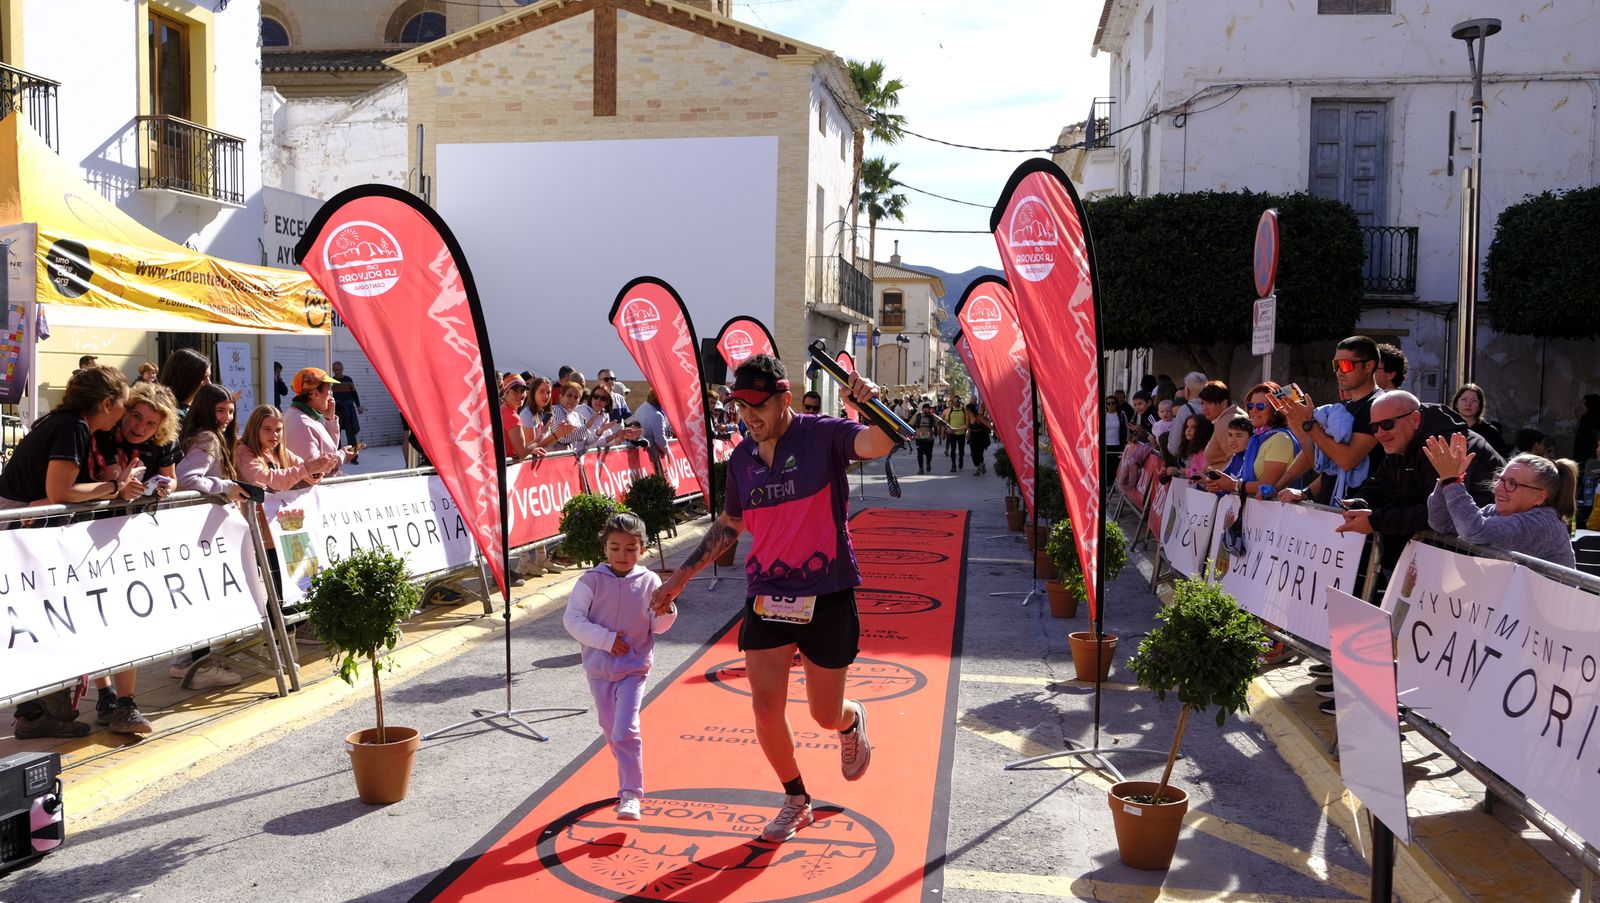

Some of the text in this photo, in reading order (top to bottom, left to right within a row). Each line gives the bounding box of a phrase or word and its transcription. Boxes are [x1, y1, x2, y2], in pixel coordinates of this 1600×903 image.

[514, 480, 573, 520] VEOLIA
[322, 501, 436, 528] AYUNTAMIENTO
[200, 537, 227, 557] DE
[325, 514, 468, 565] CANTORIA
[1322, 546, 1346, 569] DE
